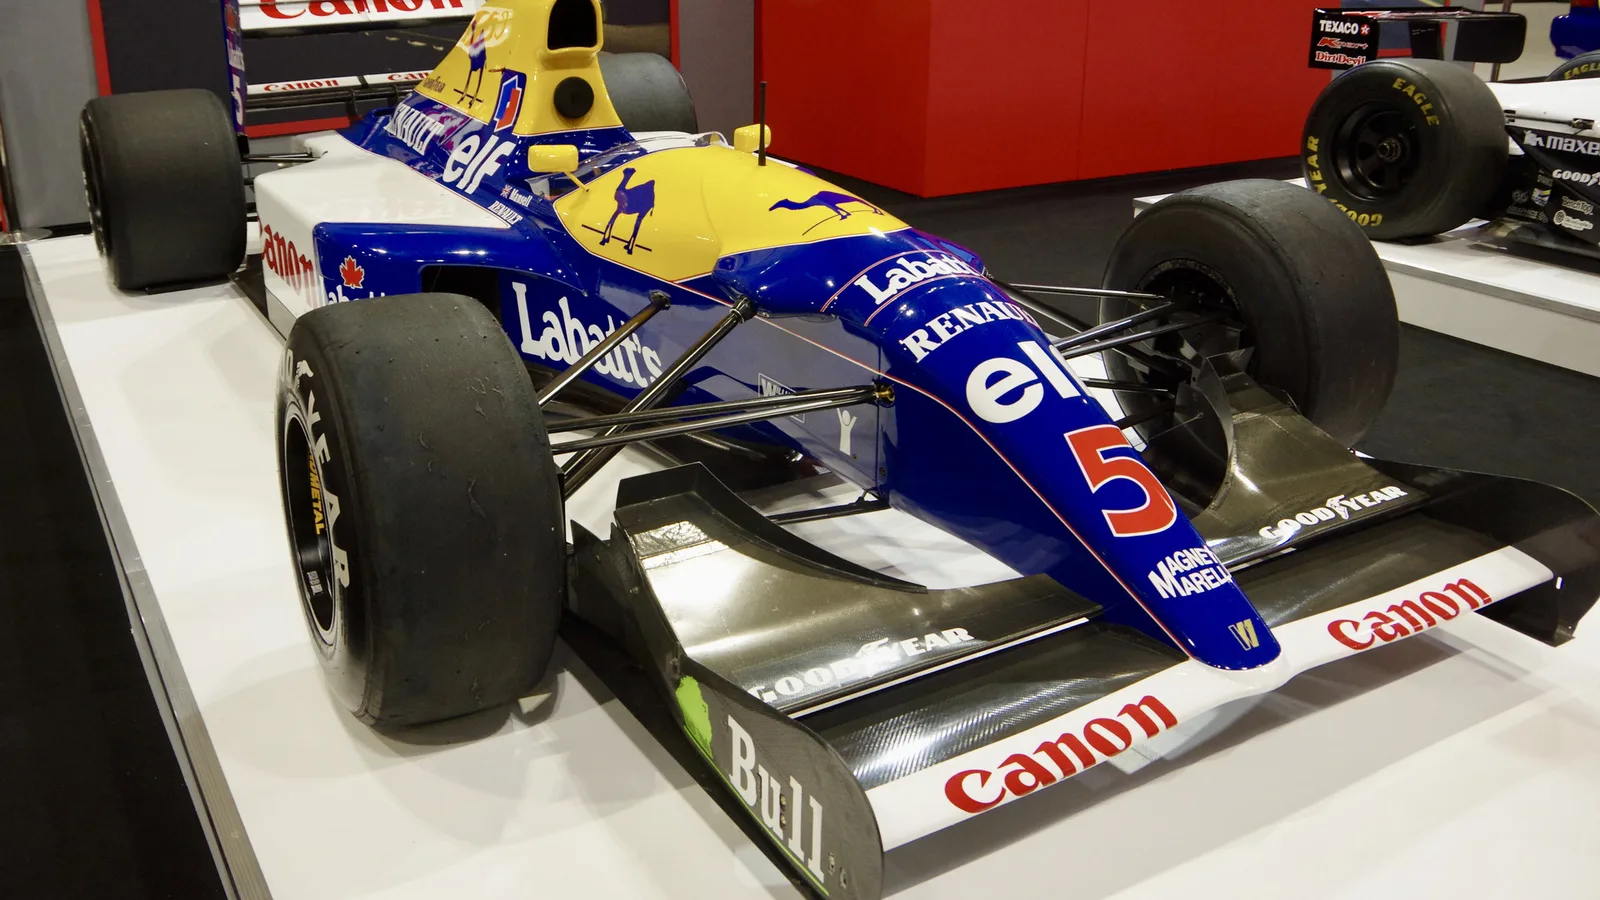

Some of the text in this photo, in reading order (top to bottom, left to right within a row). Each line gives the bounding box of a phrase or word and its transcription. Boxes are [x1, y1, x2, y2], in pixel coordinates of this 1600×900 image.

[1319, 20, 1359, 35] TEXACO
[387, 72, 429, 81] Can
[1315, 50, 1367, 67] Dirt Devil
[263, 79, 340, 92] Canon
[1392, 77, 1440, 126] EAGLE
[443, 134, 517, 195] elf
[1546, 135, 1600, 156] maxe
[488, 200, 523, 225] RENAULT
[509, 188, 533, 208] Mansell
[257, 215, 316, 310] anon
[966, 340, 1095, 424] el
[1063, 424, 1178, 537] 5
[1258, 485, 1408, 541] GOODYEAR
[1326, 577, 1493, 651] Canon
[944, 695, 1179, 814] Canon
[727, 714, 825, 884] Bull
